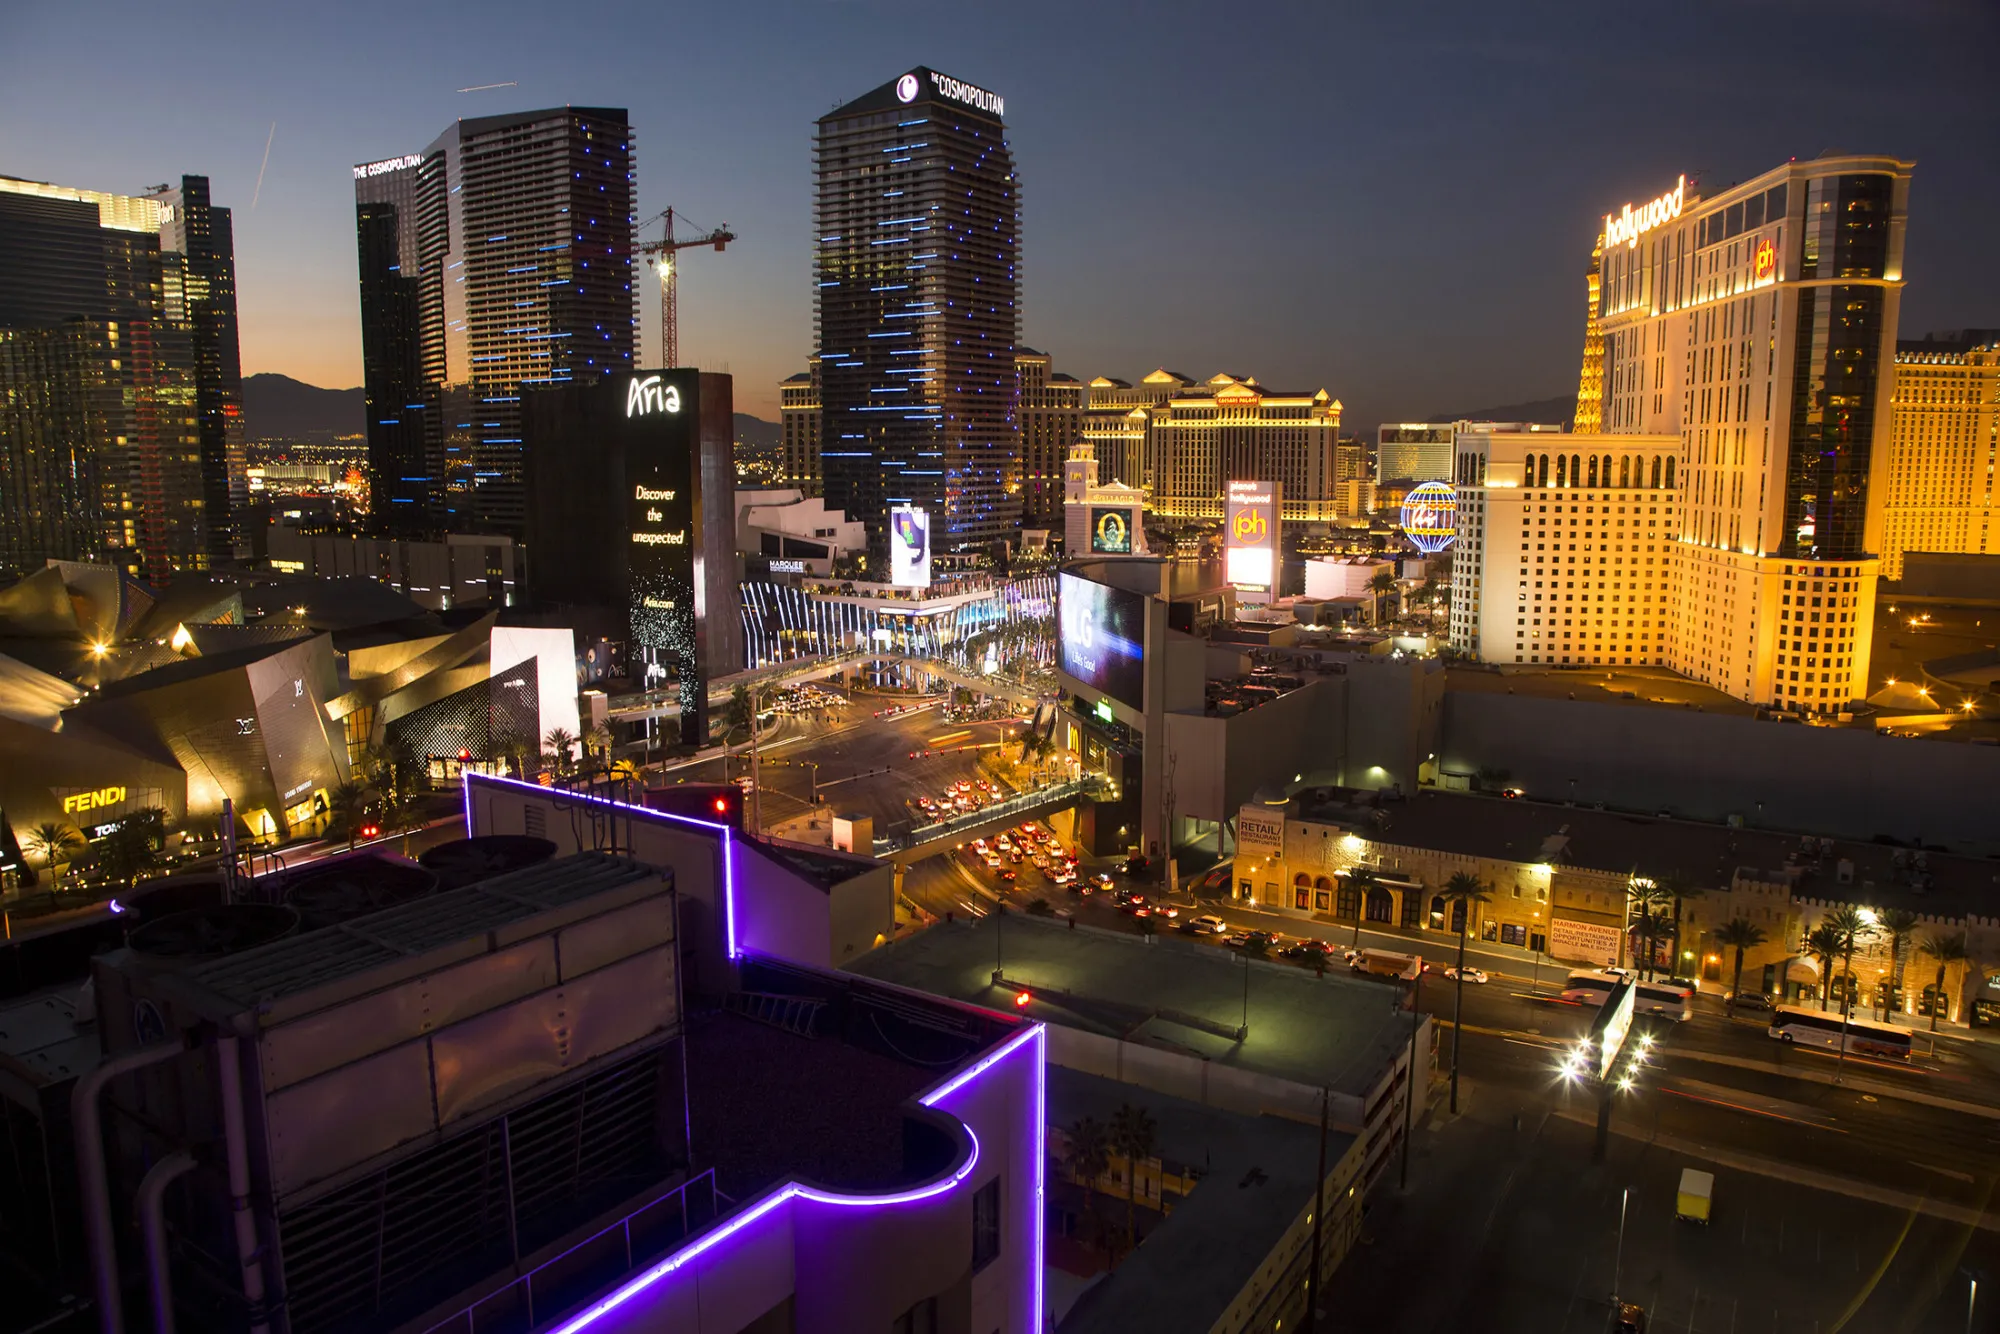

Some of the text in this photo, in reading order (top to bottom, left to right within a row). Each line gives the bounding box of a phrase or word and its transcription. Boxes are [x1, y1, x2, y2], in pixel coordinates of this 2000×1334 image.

[930, 72, 1004, 116] THE COSMOPOLITAN
[353, 153, 421, 179] THE COSMOPOLITAN
[1606, 174, 1685, 249] hollywood
[627, 375, 680, 418] Aria
[635, 485, 675, 501] Discover
[1230, 481, 1258, 493] planet
[1230, 493, 1271, 505] hollywood
[647, 506, 663, 521] the
[632, 529, 685, 547] unexpected
[769, 560, 804, 568] MARQUEE
[643, 596, 675, 609] Aria.com
[1071, 602, 1093, 649] LG
[1072, 650, 1096, 673] Life's Good
[647, 663, 667, 679] Aria
[64, 786, 126, 814] FENDI
[1240, 821, 1282, 836] RETAIL/
[1240, 830, 1281, 842] RESTAURANT
[1553, 920, 1618, 935] HARMON AVENUE
[1553, 932, 1607, 946] OPPORTUNITIES
[1553, 938, 1578, 946] MIRACLE
[1596, 945, 1616, 953] SHOPS
